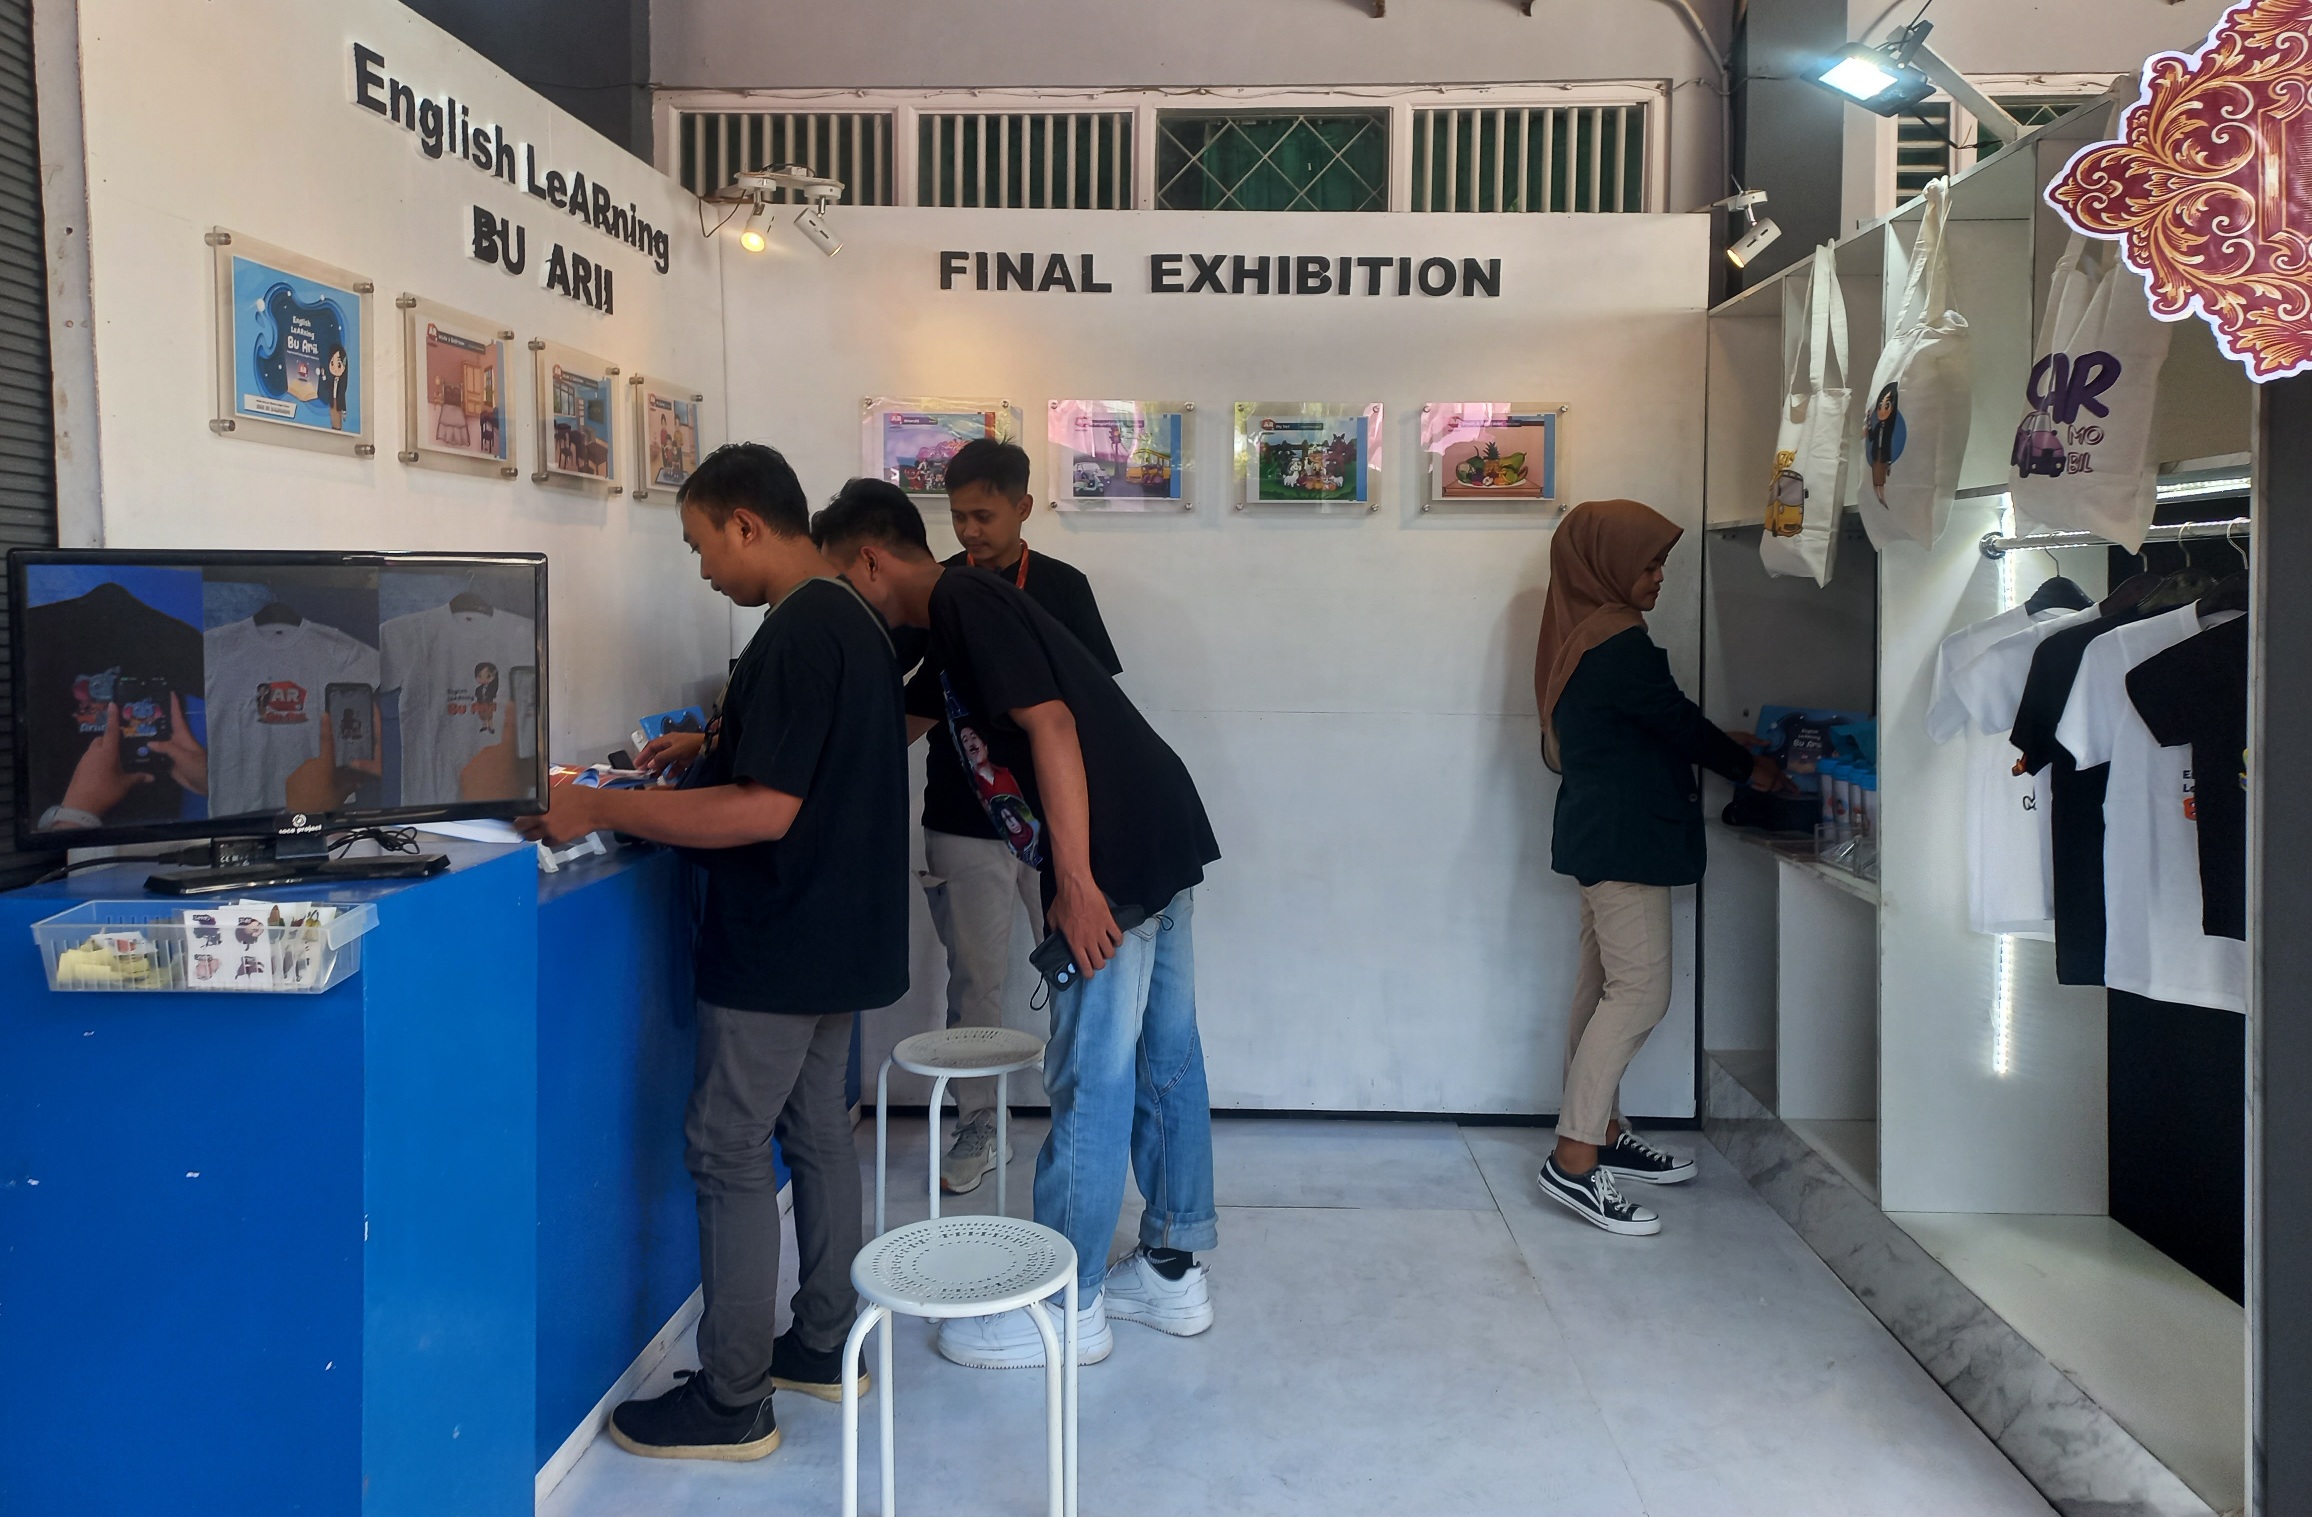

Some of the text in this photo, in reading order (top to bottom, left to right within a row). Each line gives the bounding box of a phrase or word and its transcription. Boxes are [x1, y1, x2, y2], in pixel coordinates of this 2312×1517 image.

[353, 42, 669, 275] English LeARning
[472, 204, 614, 315] BU ARII
[939, 251, 1503, 297] FINAL EXHIBITION
[292, 315, 312, 328] English
[287, 335, 300, 350] Bu
[2067, 424, 2105, 446] MO
[2066, 451, 2094, 475] BIL
[271, 687, 300, 703] AR
